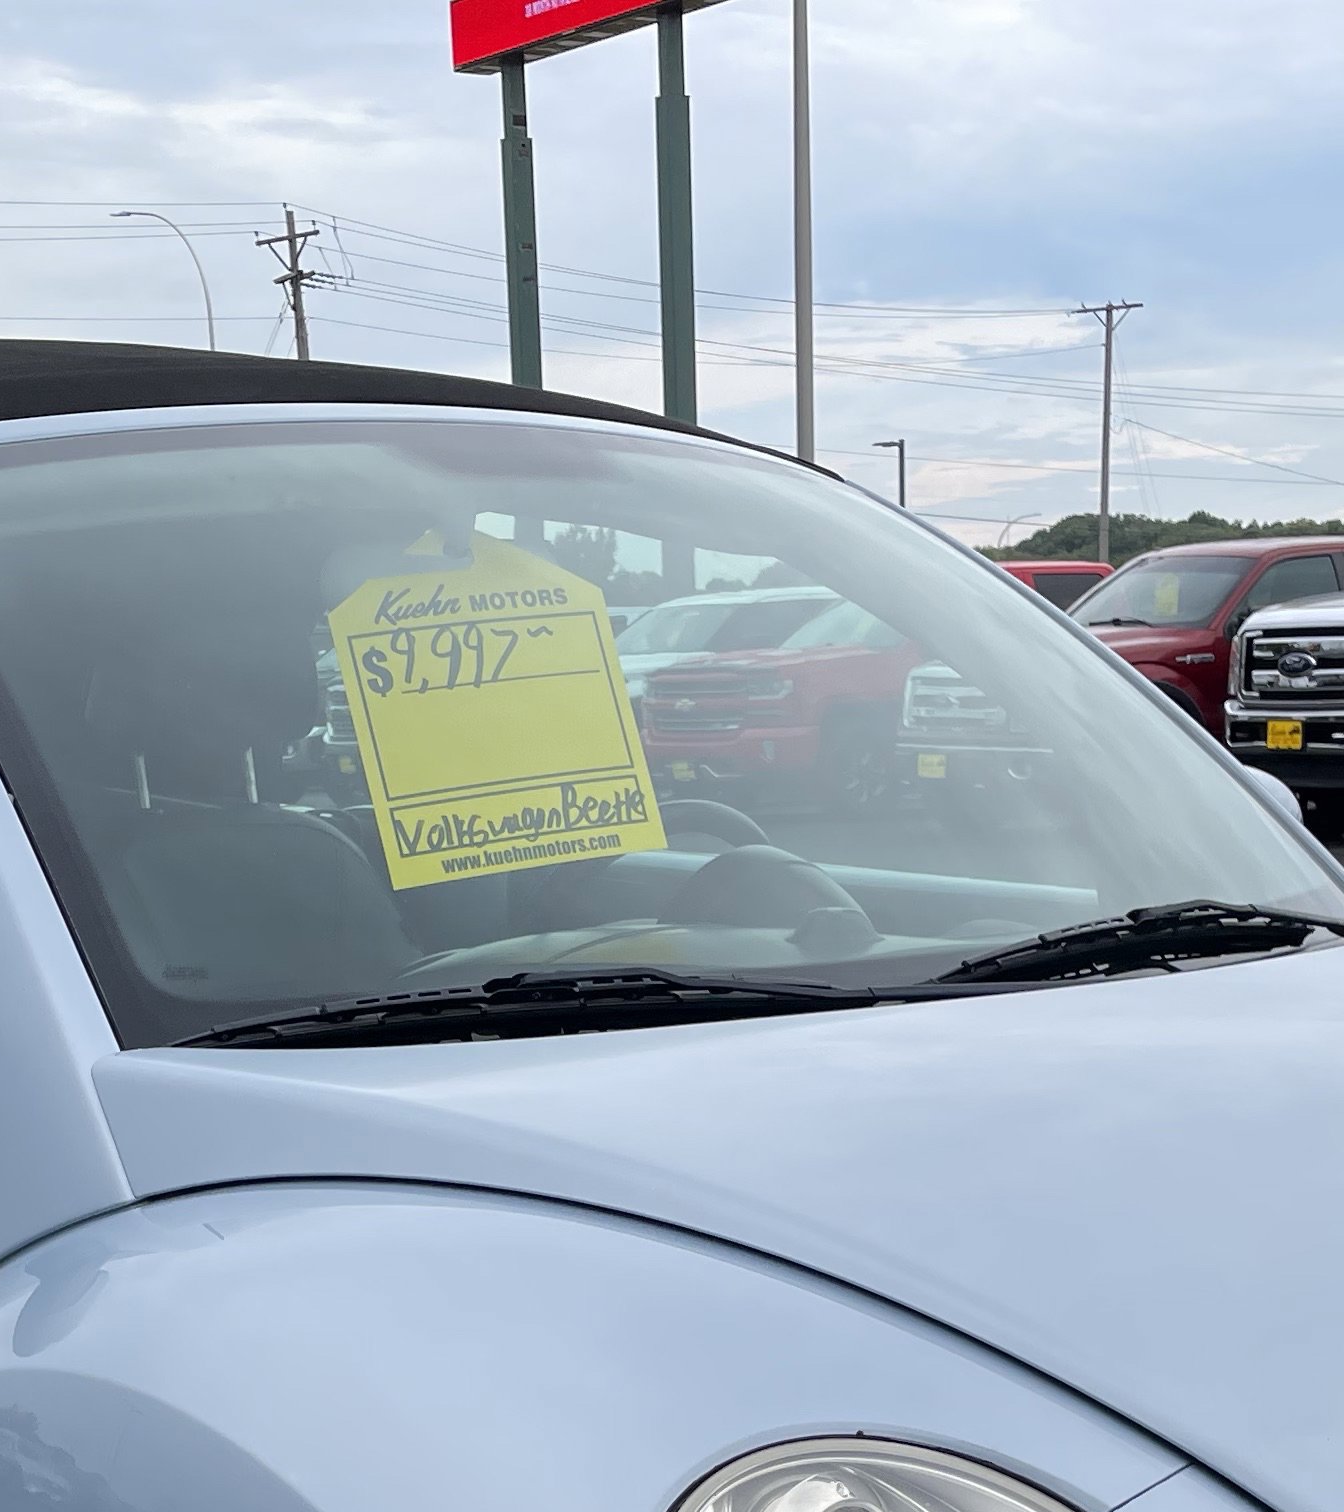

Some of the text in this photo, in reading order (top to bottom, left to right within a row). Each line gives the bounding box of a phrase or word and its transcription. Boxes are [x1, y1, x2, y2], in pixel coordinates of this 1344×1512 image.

[374, 584, 568, 625] Kuehn MOTORS
[441, 833, 622, 874] www.kuehnmotors.com
